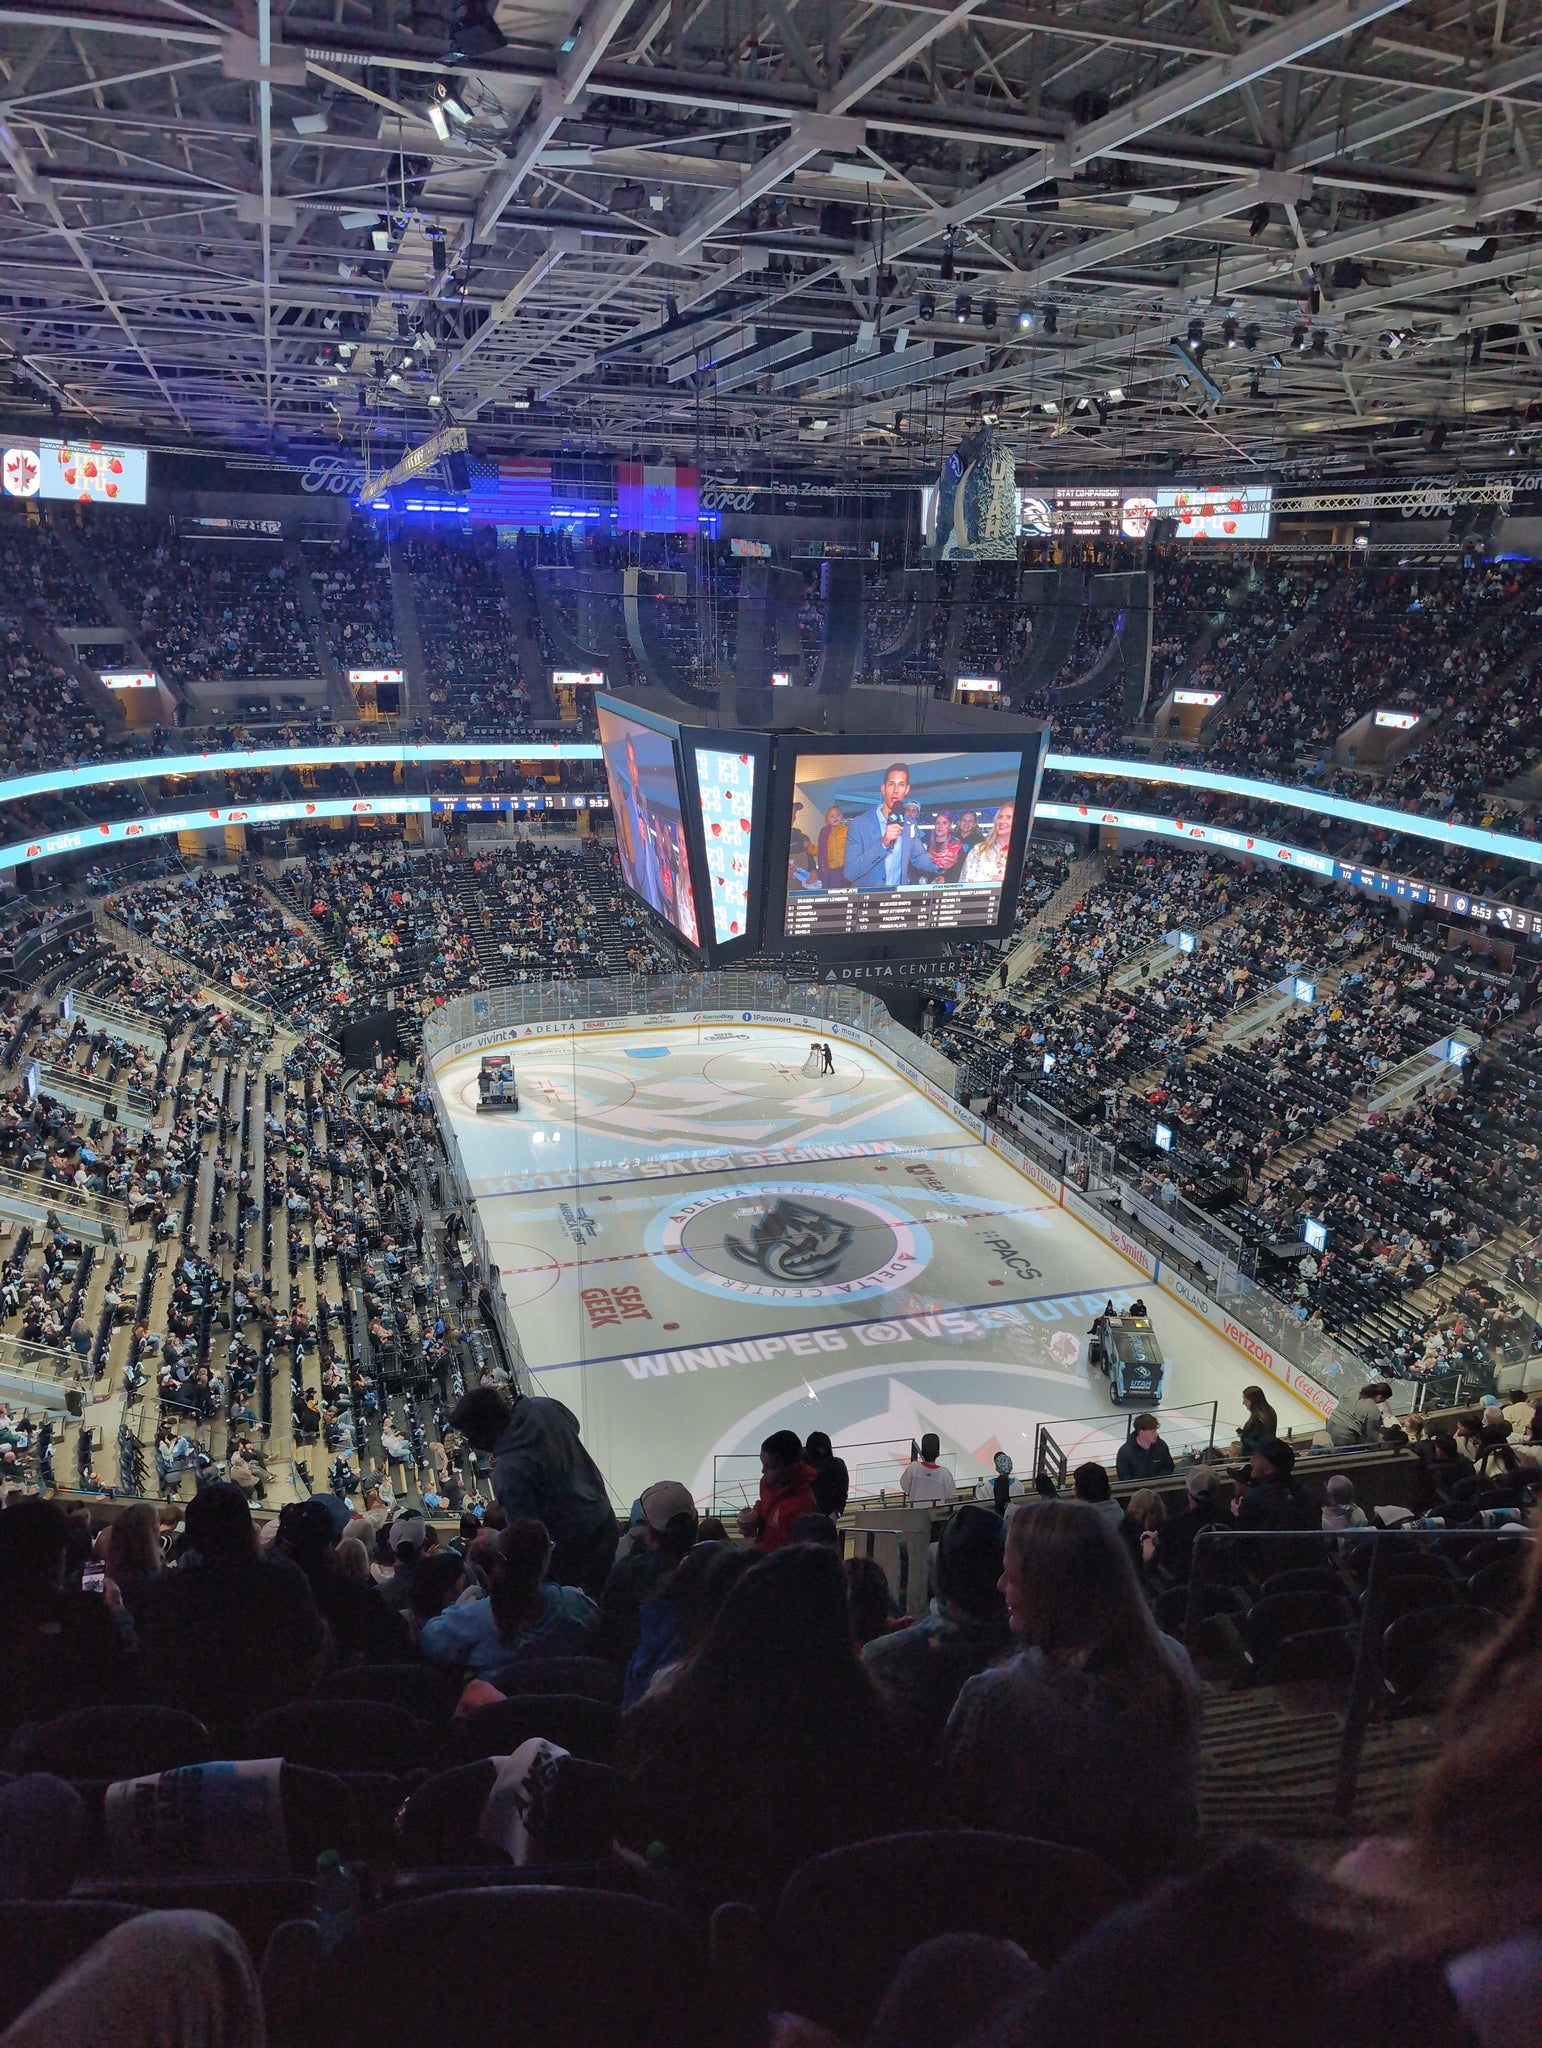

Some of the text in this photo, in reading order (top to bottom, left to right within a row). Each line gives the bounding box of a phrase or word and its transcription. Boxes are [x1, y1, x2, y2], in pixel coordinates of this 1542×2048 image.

[301, 455, 372, 494] For
[1057, 489, 1120, 498] STAT COMPARISON
[589, 798, 609, 808] 9:53
[1443, 894, 1449, 907] 1
[1470, 905, 1492, 921] 9:53
[1516, 915, 1526, 929] 3
[1391, 938, 1441, 966] HealthEquity
[842, 962, 956, 979] DELTA CENTER
[536, 1023, 576, 1034] DELTA
[753, 1013, 792, 1024] 1Password
[680, 1186, 849, 1215] DELTA CENTER
[984, 1239, 1043, 1280] PACS
[721, 1262, 908, 1298] DELTA CENTER
[580, 1288, 622, 1329] GEEK
[610, 1286, 653, 1320] SEAT
[1176, 1282, 1209, 1314] OKLAND
[620, 1289, 1140, 1380] WINNIPEG VS UTAH
[1223, 1317, 1273, 1369] verizon
